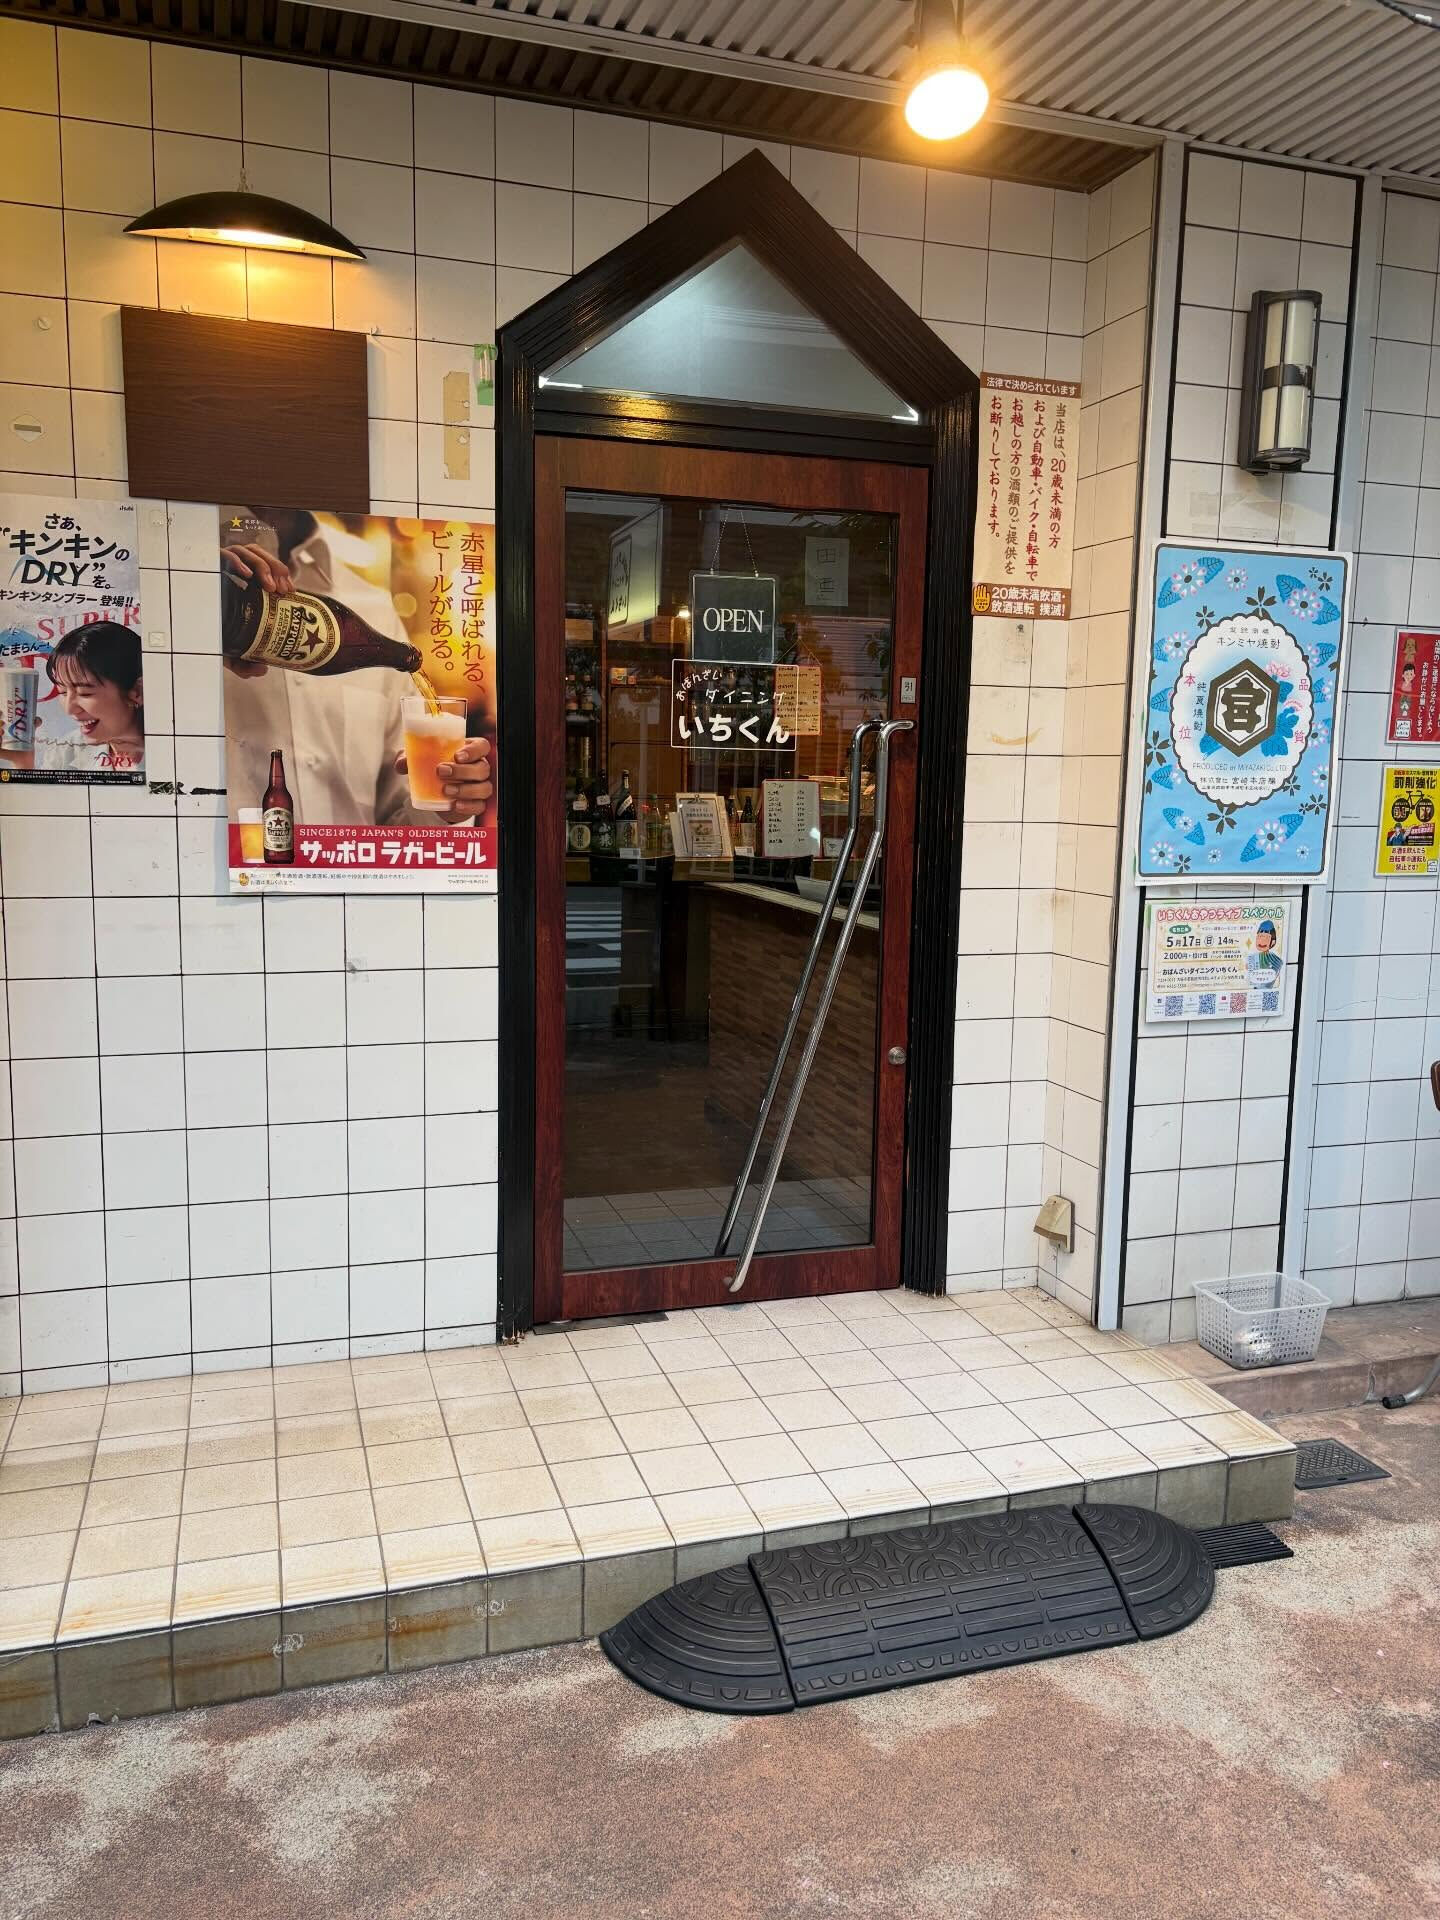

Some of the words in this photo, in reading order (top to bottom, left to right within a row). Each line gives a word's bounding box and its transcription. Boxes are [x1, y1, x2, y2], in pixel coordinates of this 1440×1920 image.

[986, 376, 1077, 396] 法律で決められています
[987, 395, 1003, 538] お断りしております。
[1049, 402, 1067, 549] 当店は、20歳未満の方
[1004, 396, 1025, 575] お越しの方の酒類のご提供を
[1025, 399, 1047, 581] および自動車・バイク・自転車で
[44, 513, 82, 531] さあ、
[0, 589, 97, 605] キンキンタンブラー
[430, 530, 454, 672] ビールがある。
[991, 600, 1036, 615] 飲酒運転
[1039, 603, 1066, 617] 撲滅!
[460, 532, 486, 694] 赤星と呼ばれる、
[703, 607, 765, 633] OPEN
[280, 608, 301, 657] SAPPORO
[676, 669, 723, 702] おばんざい
[705, 688, 787, 705] ダイニング
[678, 713, 790, 744] いちくん
[1238, 764, 1266, 772] MIYAZAKI
[361, 829, 404, 838] JAPAN'S
[408, 829, 449, 838] OLDEST
[300, 840, 376, 864] サッポロ
[381, 841, 487, 865] ラガービール
